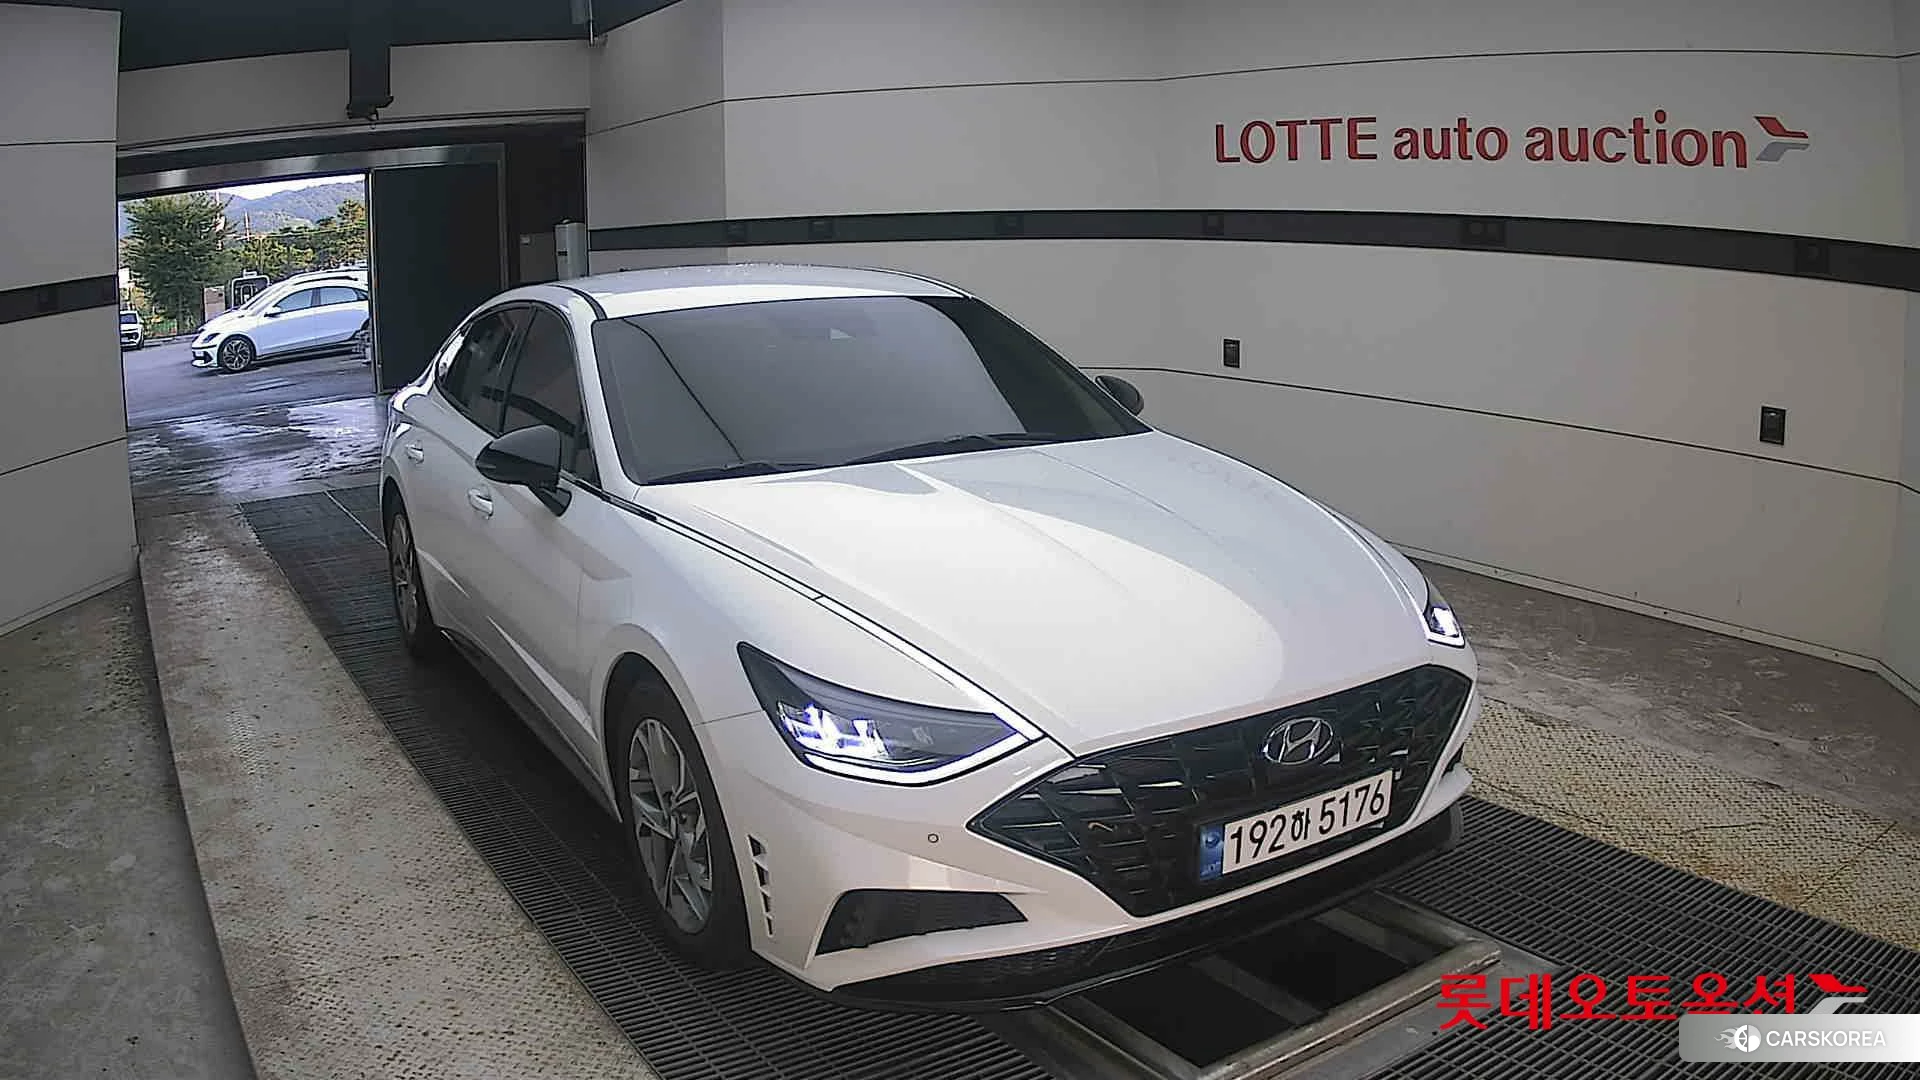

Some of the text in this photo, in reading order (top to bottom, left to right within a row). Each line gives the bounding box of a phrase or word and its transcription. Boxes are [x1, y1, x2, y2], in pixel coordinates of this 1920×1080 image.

[1215, 110, 1748, 169] LOTTE auto auction
[1231, 779, 1385, 865] 192하 5176
